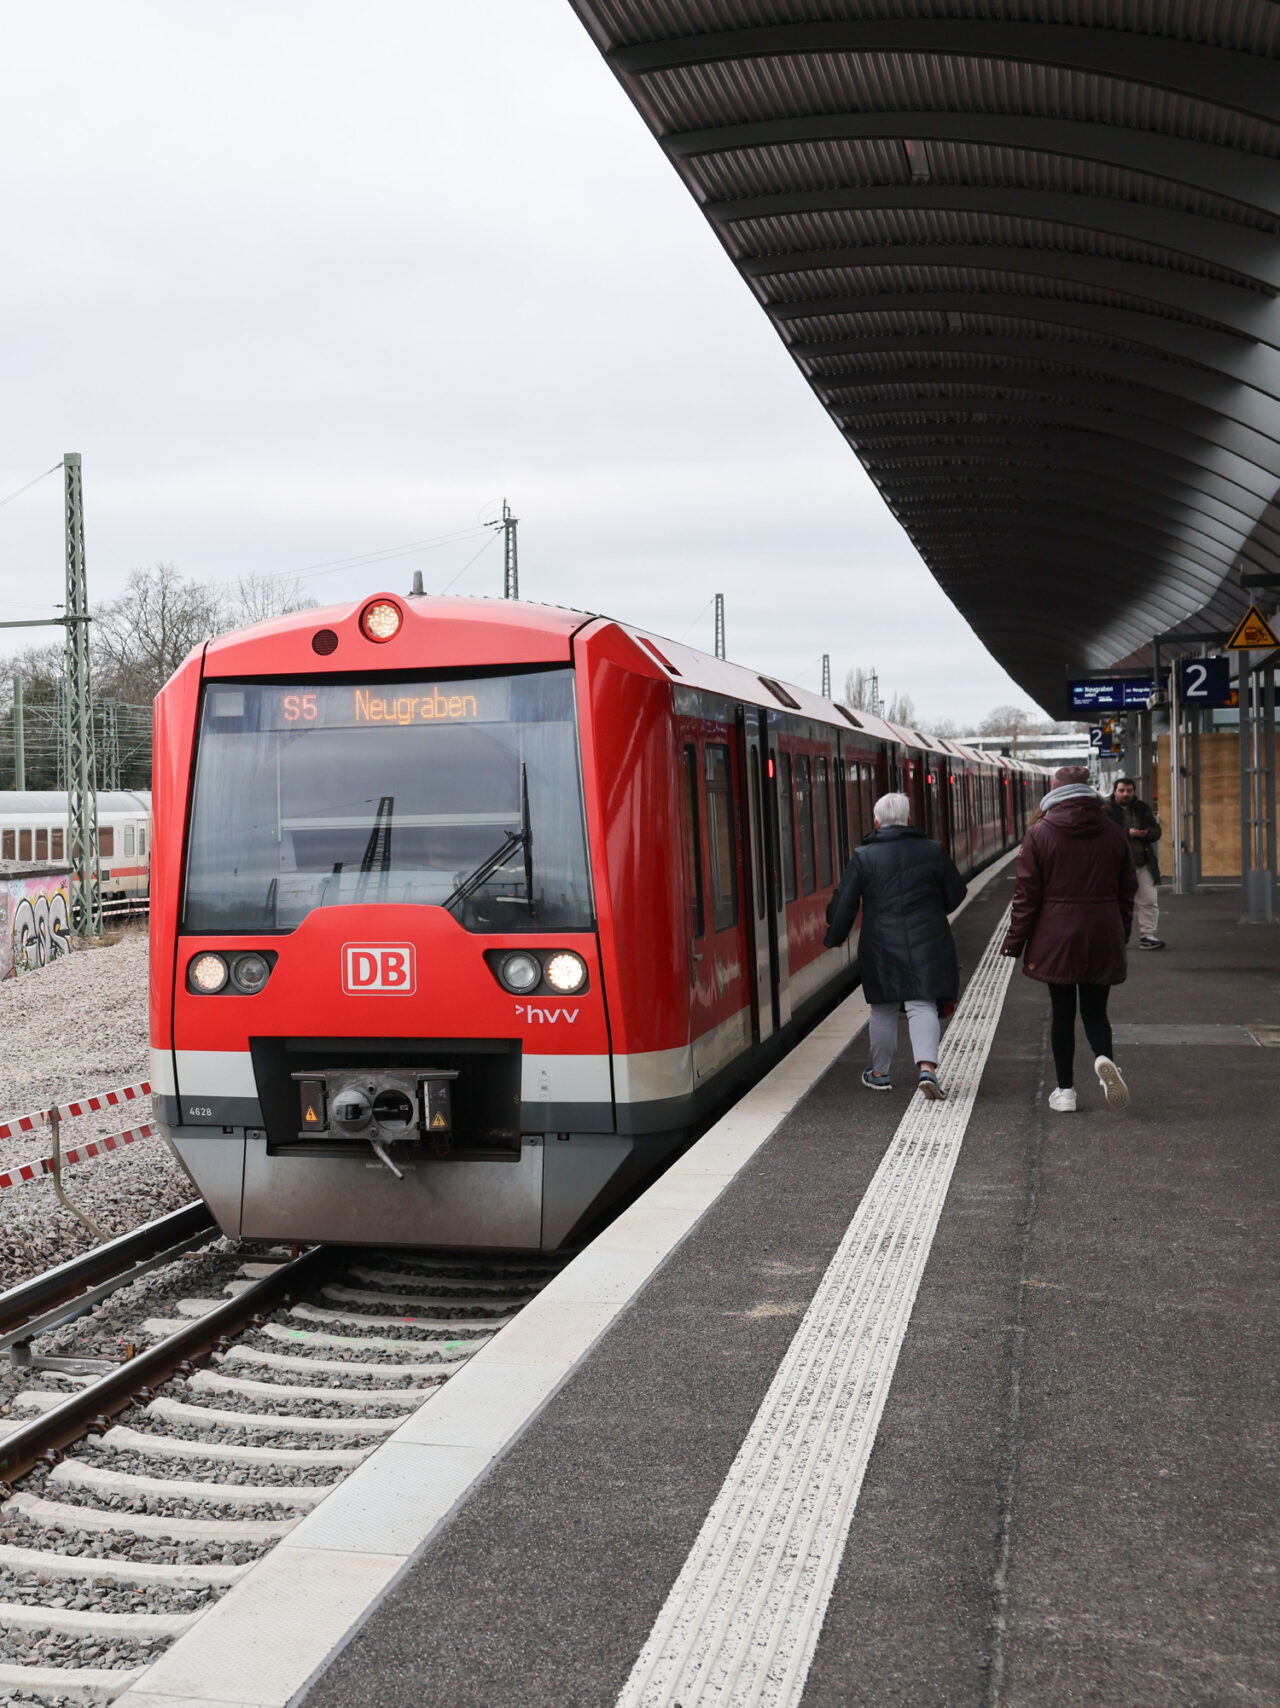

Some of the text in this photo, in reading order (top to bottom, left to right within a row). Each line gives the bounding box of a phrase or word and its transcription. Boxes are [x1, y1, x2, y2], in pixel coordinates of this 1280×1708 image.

[1186, 664, 1208, 697] 2
[283, 686, 478, 725] S5 Neugraben
[1091, 728, 1103, 746] 2
[351, 951, 407, 987] DB
[189, 1107, 212, 1117] 4628
